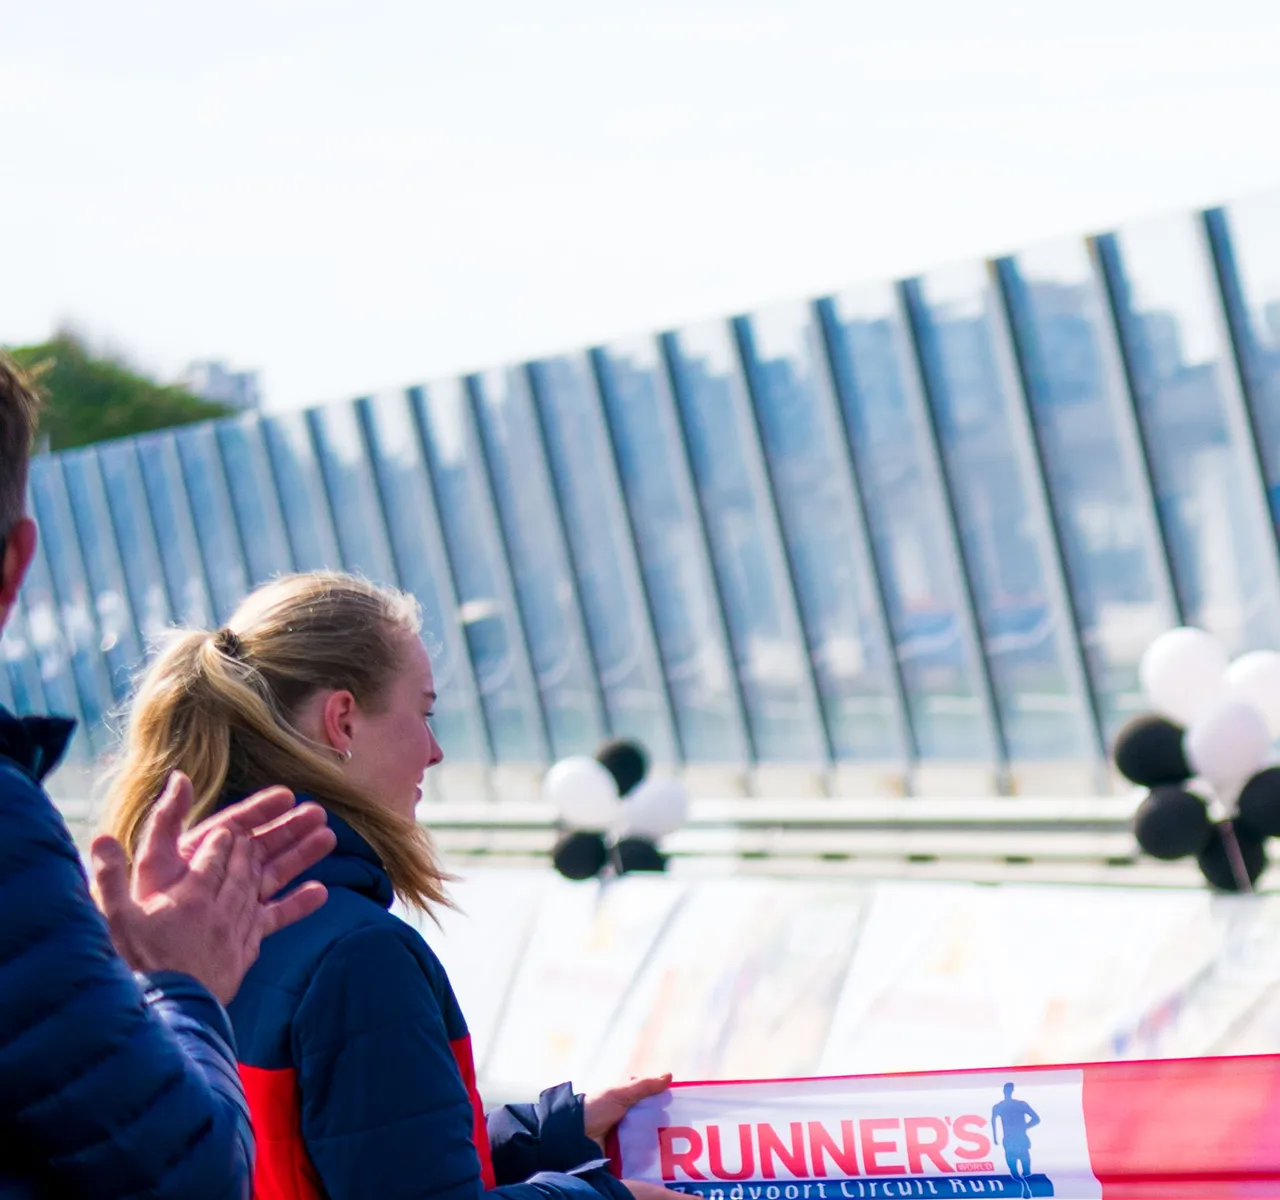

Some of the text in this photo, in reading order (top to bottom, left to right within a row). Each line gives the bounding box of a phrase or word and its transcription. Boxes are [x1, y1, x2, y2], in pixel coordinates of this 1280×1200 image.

[658, 1114, 991, 1181] RUNNER'S
[957, 1162, 993, 1172] WORLD
[840, 1179, 939, 1199] Circuit
[949, 1178, 1005, 1194] Run
